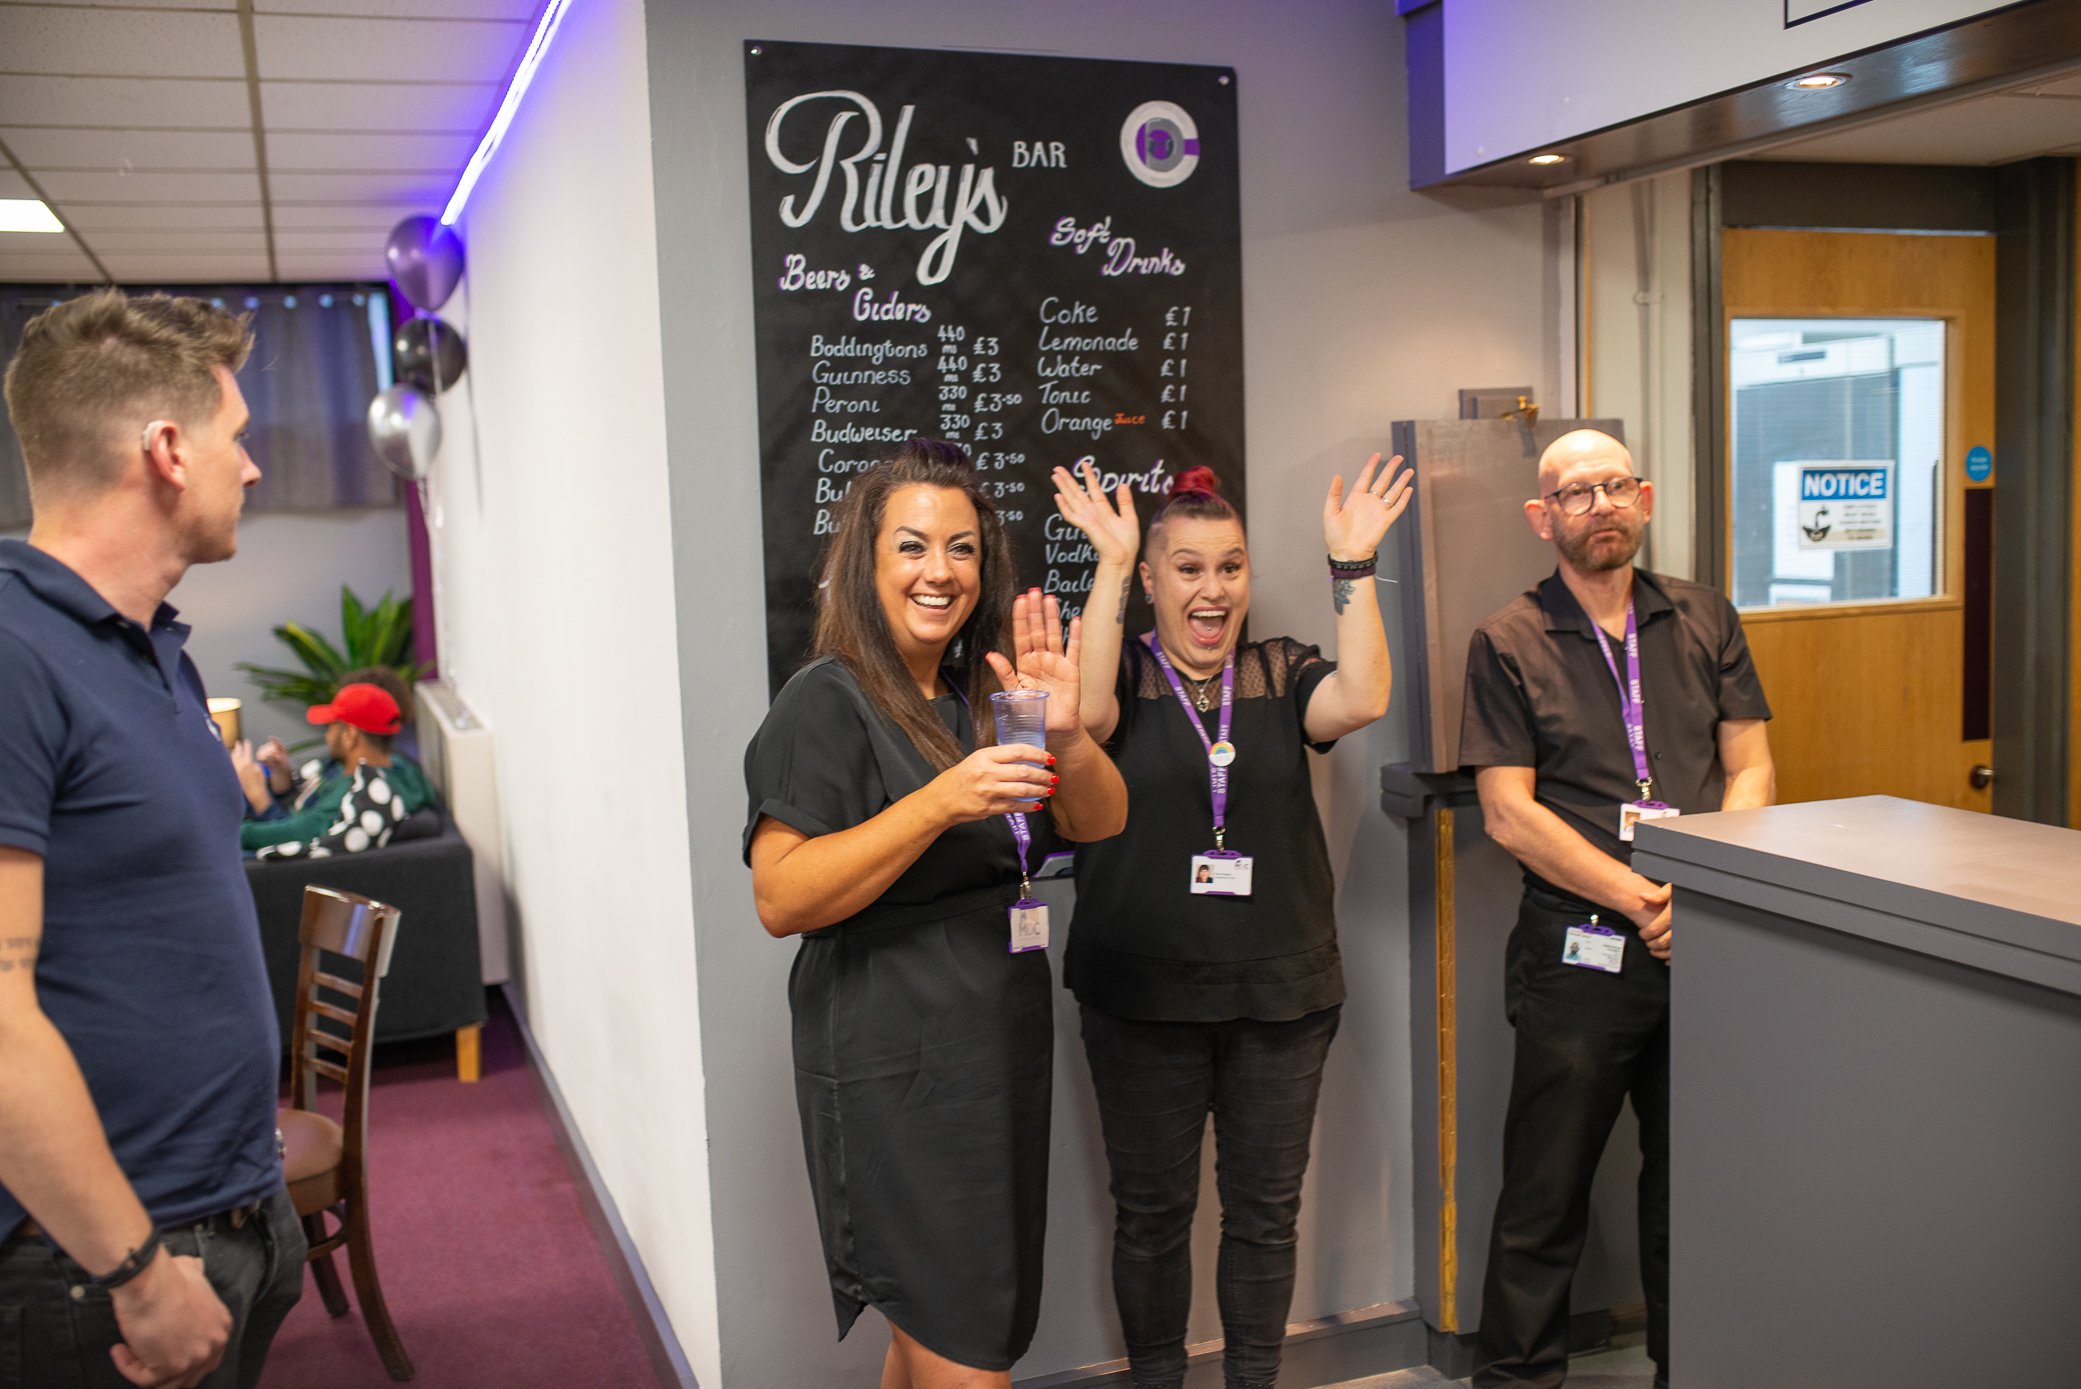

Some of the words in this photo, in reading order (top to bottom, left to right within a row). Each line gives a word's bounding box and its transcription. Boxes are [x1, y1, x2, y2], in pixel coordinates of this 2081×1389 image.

[1011, 141, 1067, 169] BAR
[765, 89, 1008, 286] Riley's
[1051, 215, 1112, 254] Soft
[1103, 237, 1186, 276] Drinks
[779, 253, 851, 291] Beers
[853, 287, 932, 323] Ciders
[1040, 297, 1099, 324] Coke
[810, 334, 928, 365] Boddingtons
[937, 324, 966, 342] 440
[1038, 326, 1139, 351] Lemonade
[811, 360, 912, 385] Guinness
[937, 355, 968, 373] 440
[1037, 355, 1103, 378] Water
[811, 385, 881, 414] Peroni
[938, 385, 967, 401] 330
[1038, 380, 1091, 404] Tonic
[811, 419, 918, 443] Budweiser
[940, 414, 971, 430] 330
[1041, 407, 1113, 440] Orange
[1803, 471, 1885, 497] NOTICE
[1627, 632, 1638, 658] STAFF
[1174, 685, 1191, 706] STAFF
[1222, 685, 1232, 706] STAFF
[1630, 678, 1641, 704] STAFF
[1633, 725, 1644, 751] STAFF
